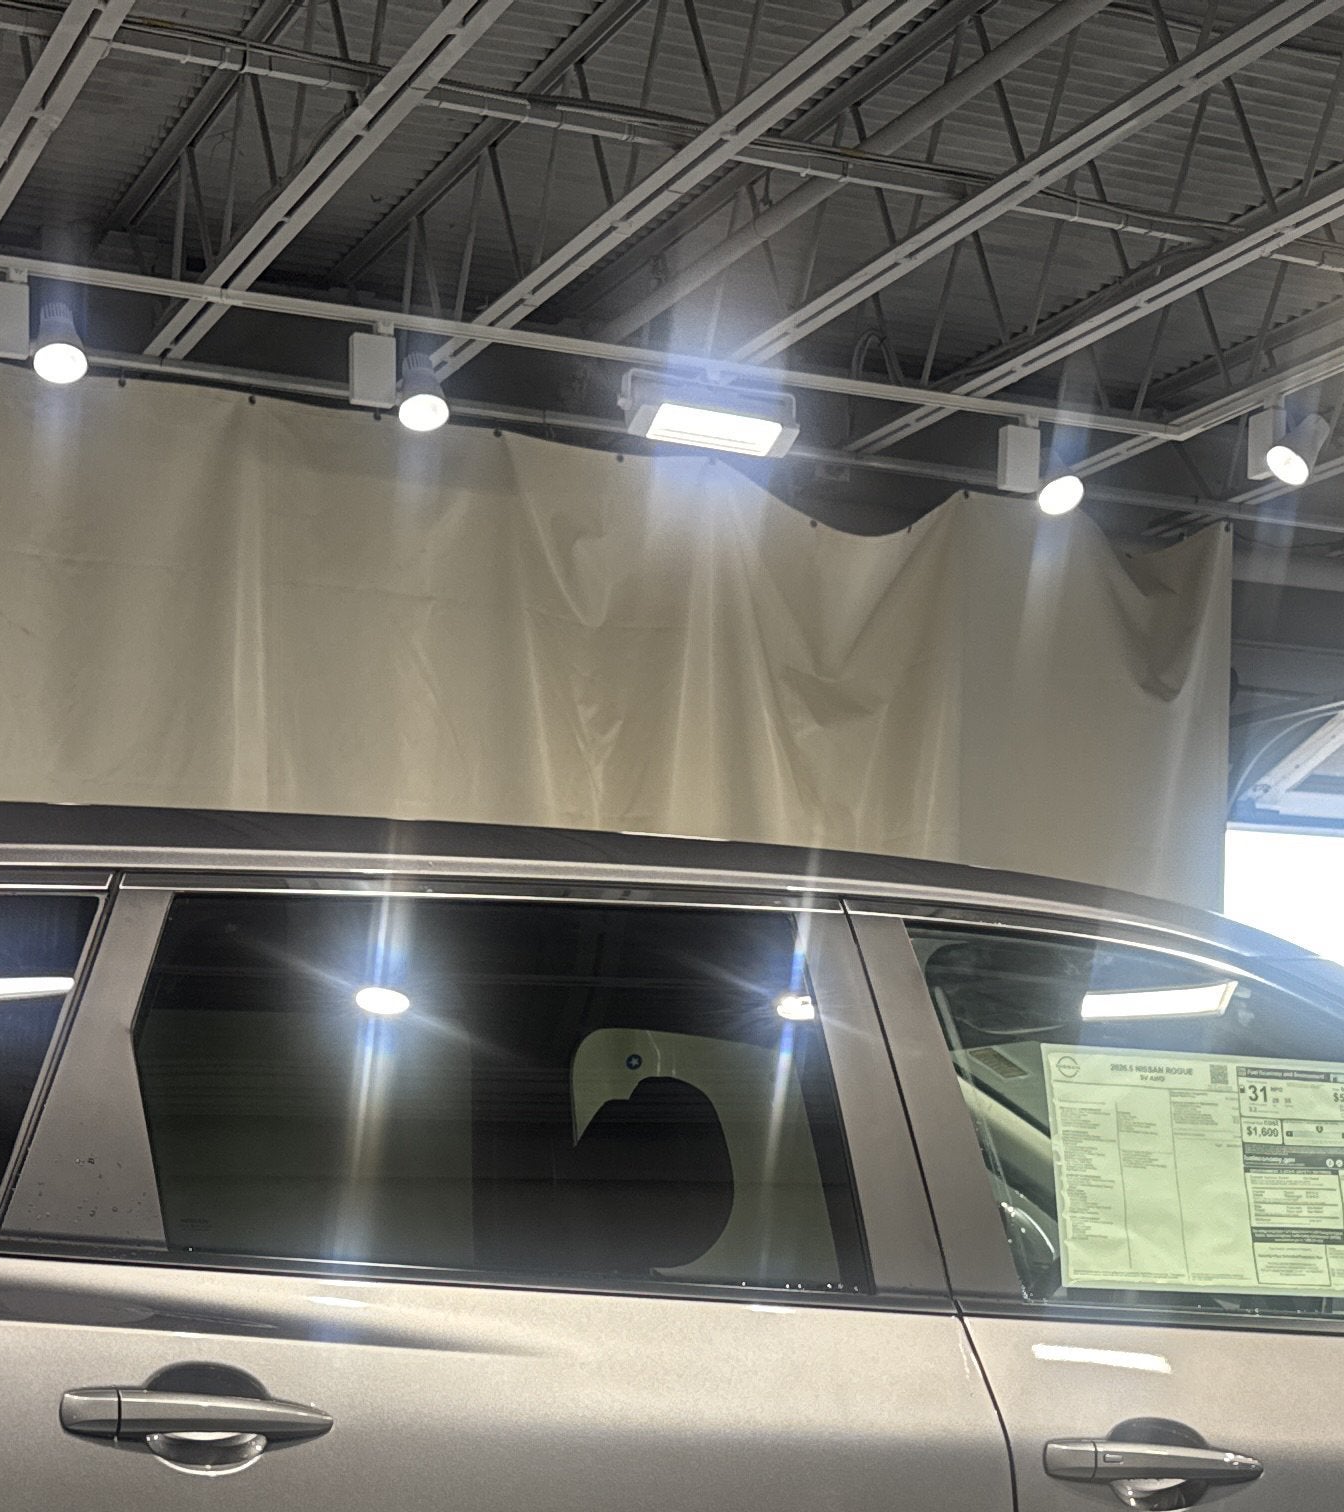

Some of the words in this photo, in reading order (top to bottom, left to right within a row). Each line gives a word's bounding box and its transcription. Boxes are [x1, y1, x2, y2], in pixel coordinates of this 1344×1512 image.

[1135, 1065, 1163, 1074] NISSAN
[1165, 1067, 1194, 1076] ROGUE
[1248, 1084, 1268, 1102] 31
